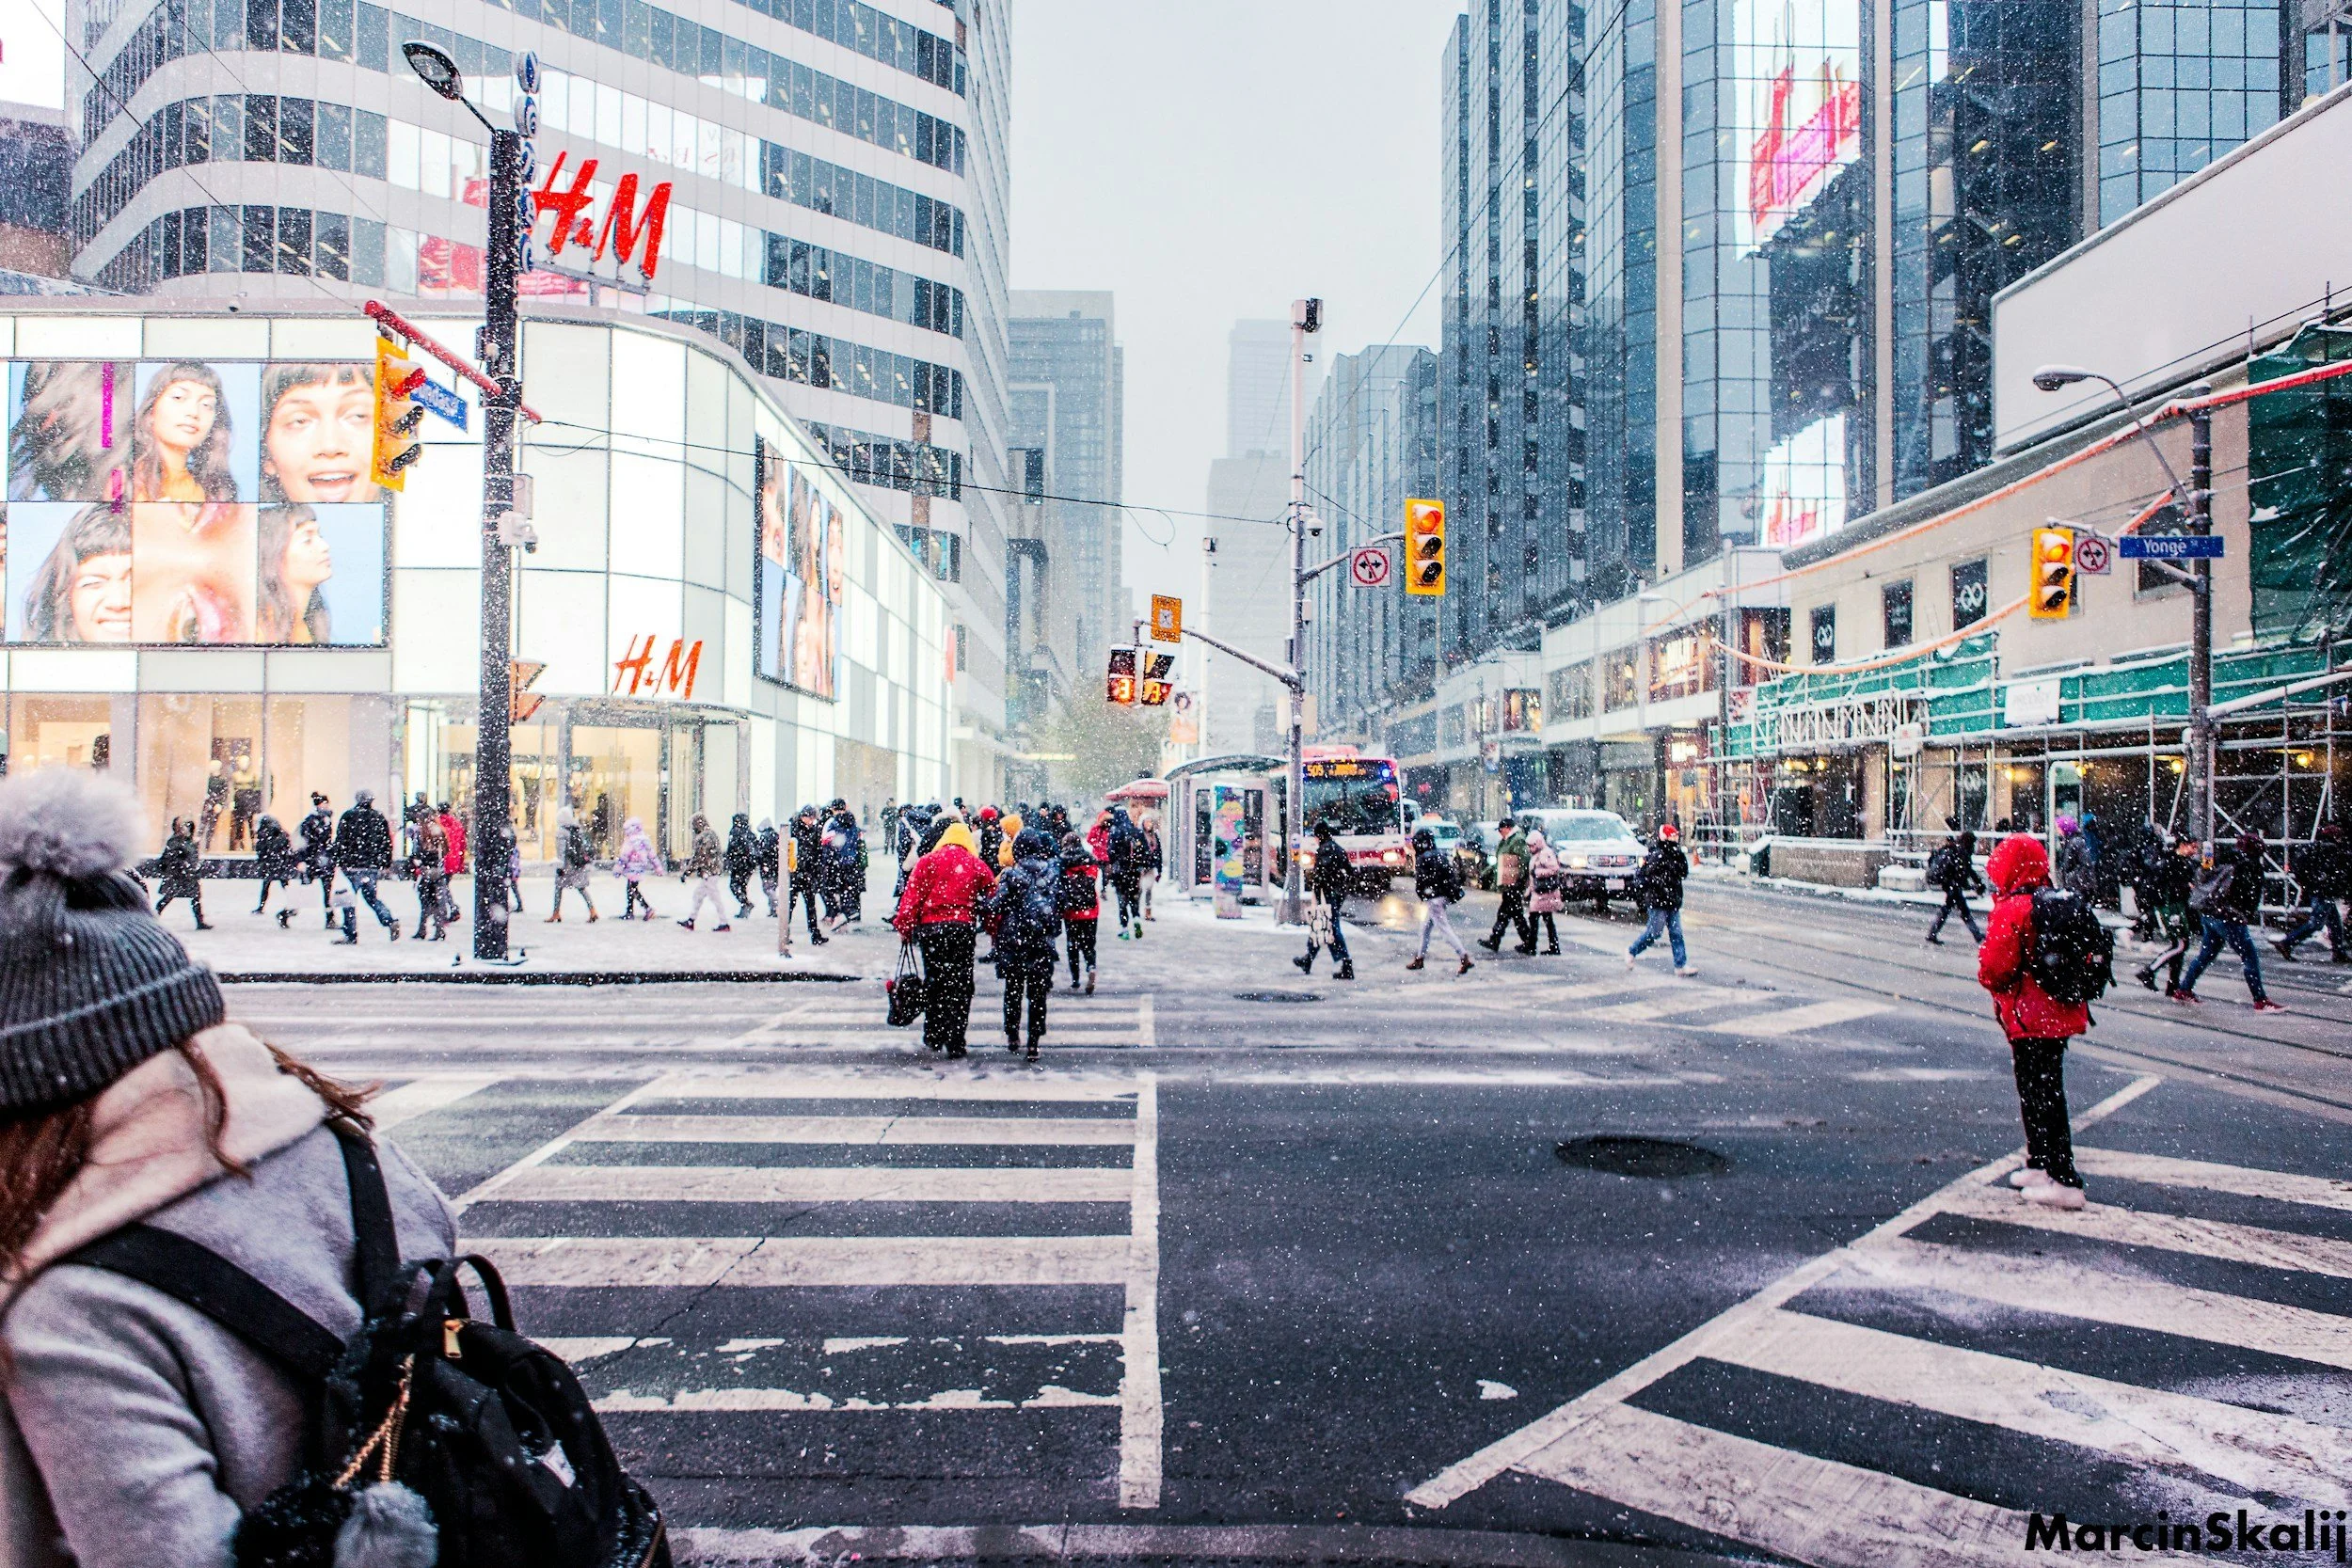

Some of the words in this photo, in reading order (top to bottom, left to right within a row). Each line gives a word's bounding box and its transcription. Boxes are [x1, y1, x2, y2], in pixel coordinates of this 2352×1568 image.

[530, 150, 673, 279] H&M
[2144, 539, 2187, 556] Yonge
[613, 634, 703, 700] H&M
[1307, 764, 1325, 777] 505
